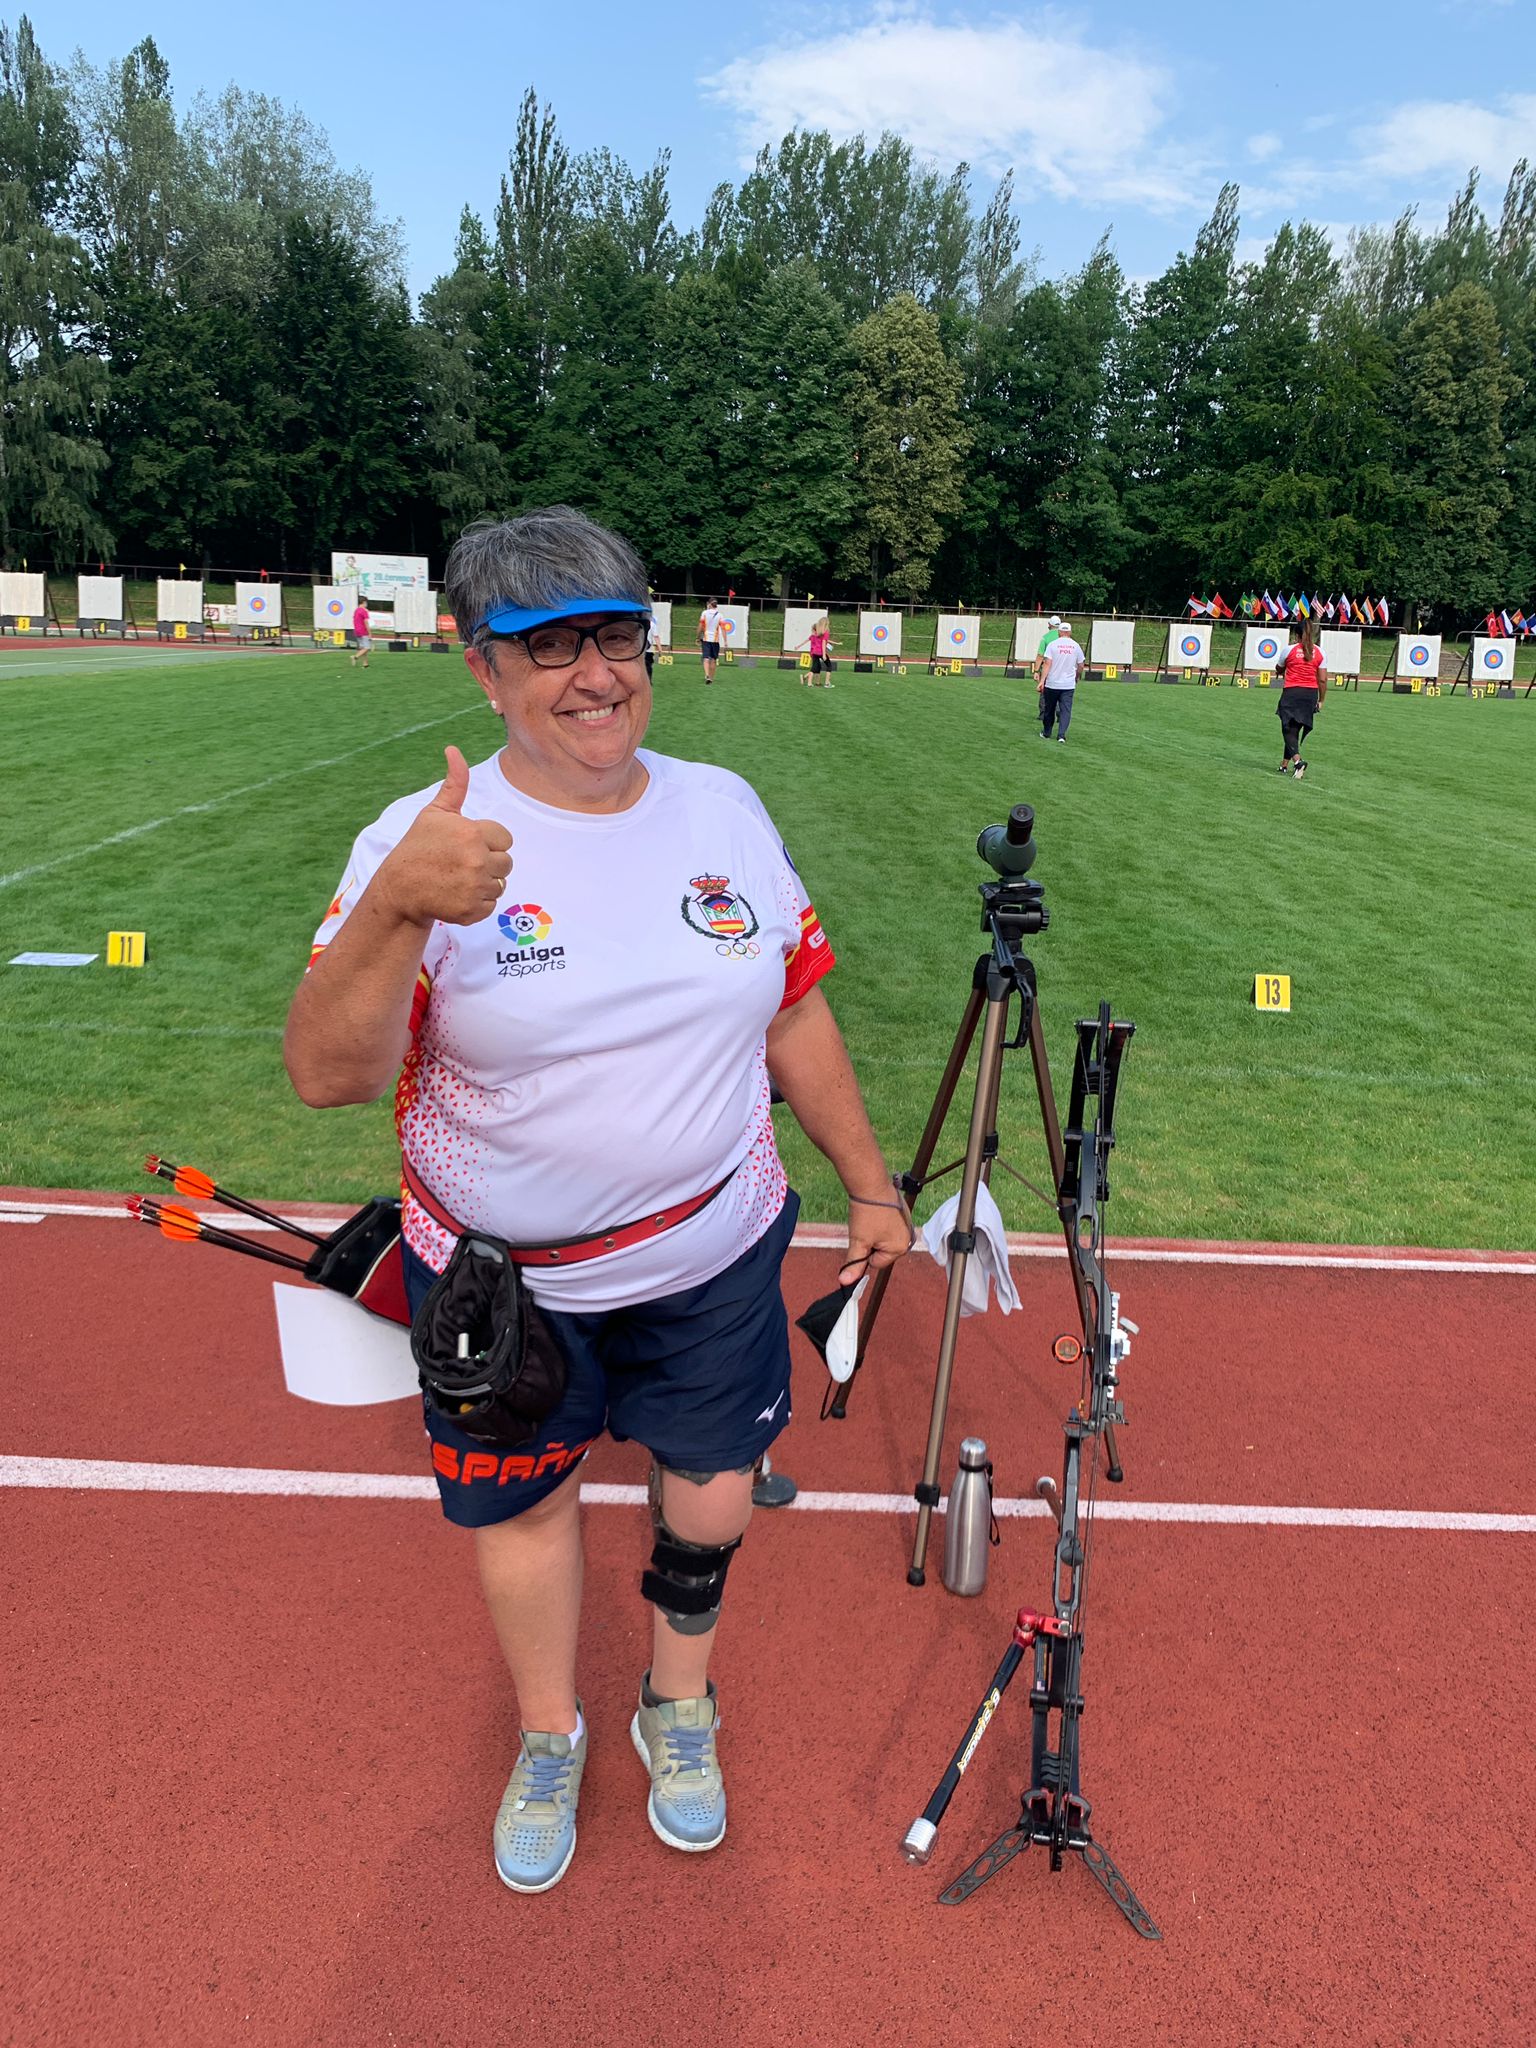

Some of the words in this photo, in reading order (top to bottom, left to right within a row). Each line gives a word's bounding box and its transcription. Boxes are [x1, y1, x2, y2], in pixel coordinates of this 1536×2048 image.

[1205, 677, 1220, 687] 102
[1237, 678, 1249, 688] 99
[1426, 687, 1440, 696] 103
[1472, 688, 1484, 698] 97
[1487, 683, 1495, 693] 22
[120, 936, 133, 963] 11
[496, 946, 565, 965] LaLiga
[498, 959, 566, 978] 4Sports
[1265, 978, 1281, 1006] 13
